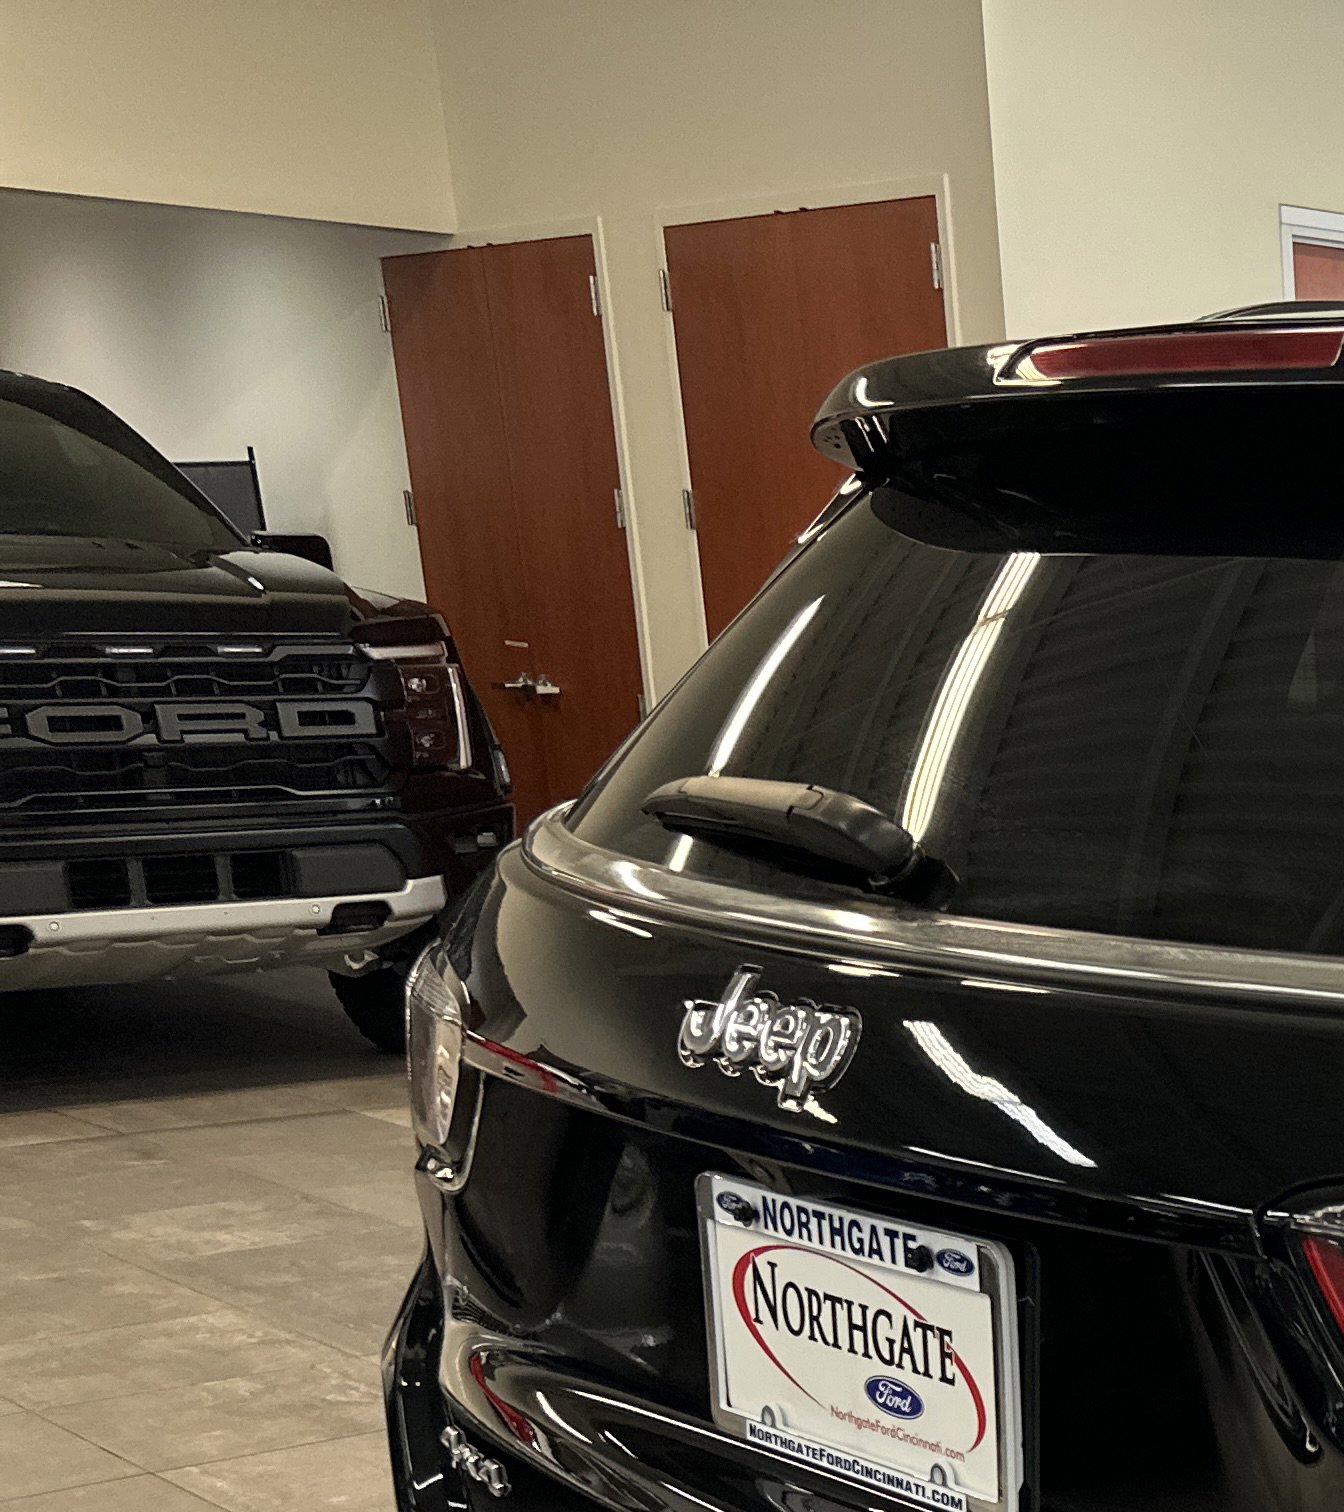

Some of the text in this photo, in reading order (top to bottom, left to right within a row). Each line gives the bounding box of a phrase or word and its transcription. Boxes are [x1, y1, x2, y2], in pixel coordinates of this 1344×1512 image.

[0, 700, 377, 743] ORD
[680, 964, 859, 1110] Jeep
[752, 1255, 956, 1387] NORTHGATE
[876, 1380, 912, 1412] Ford
